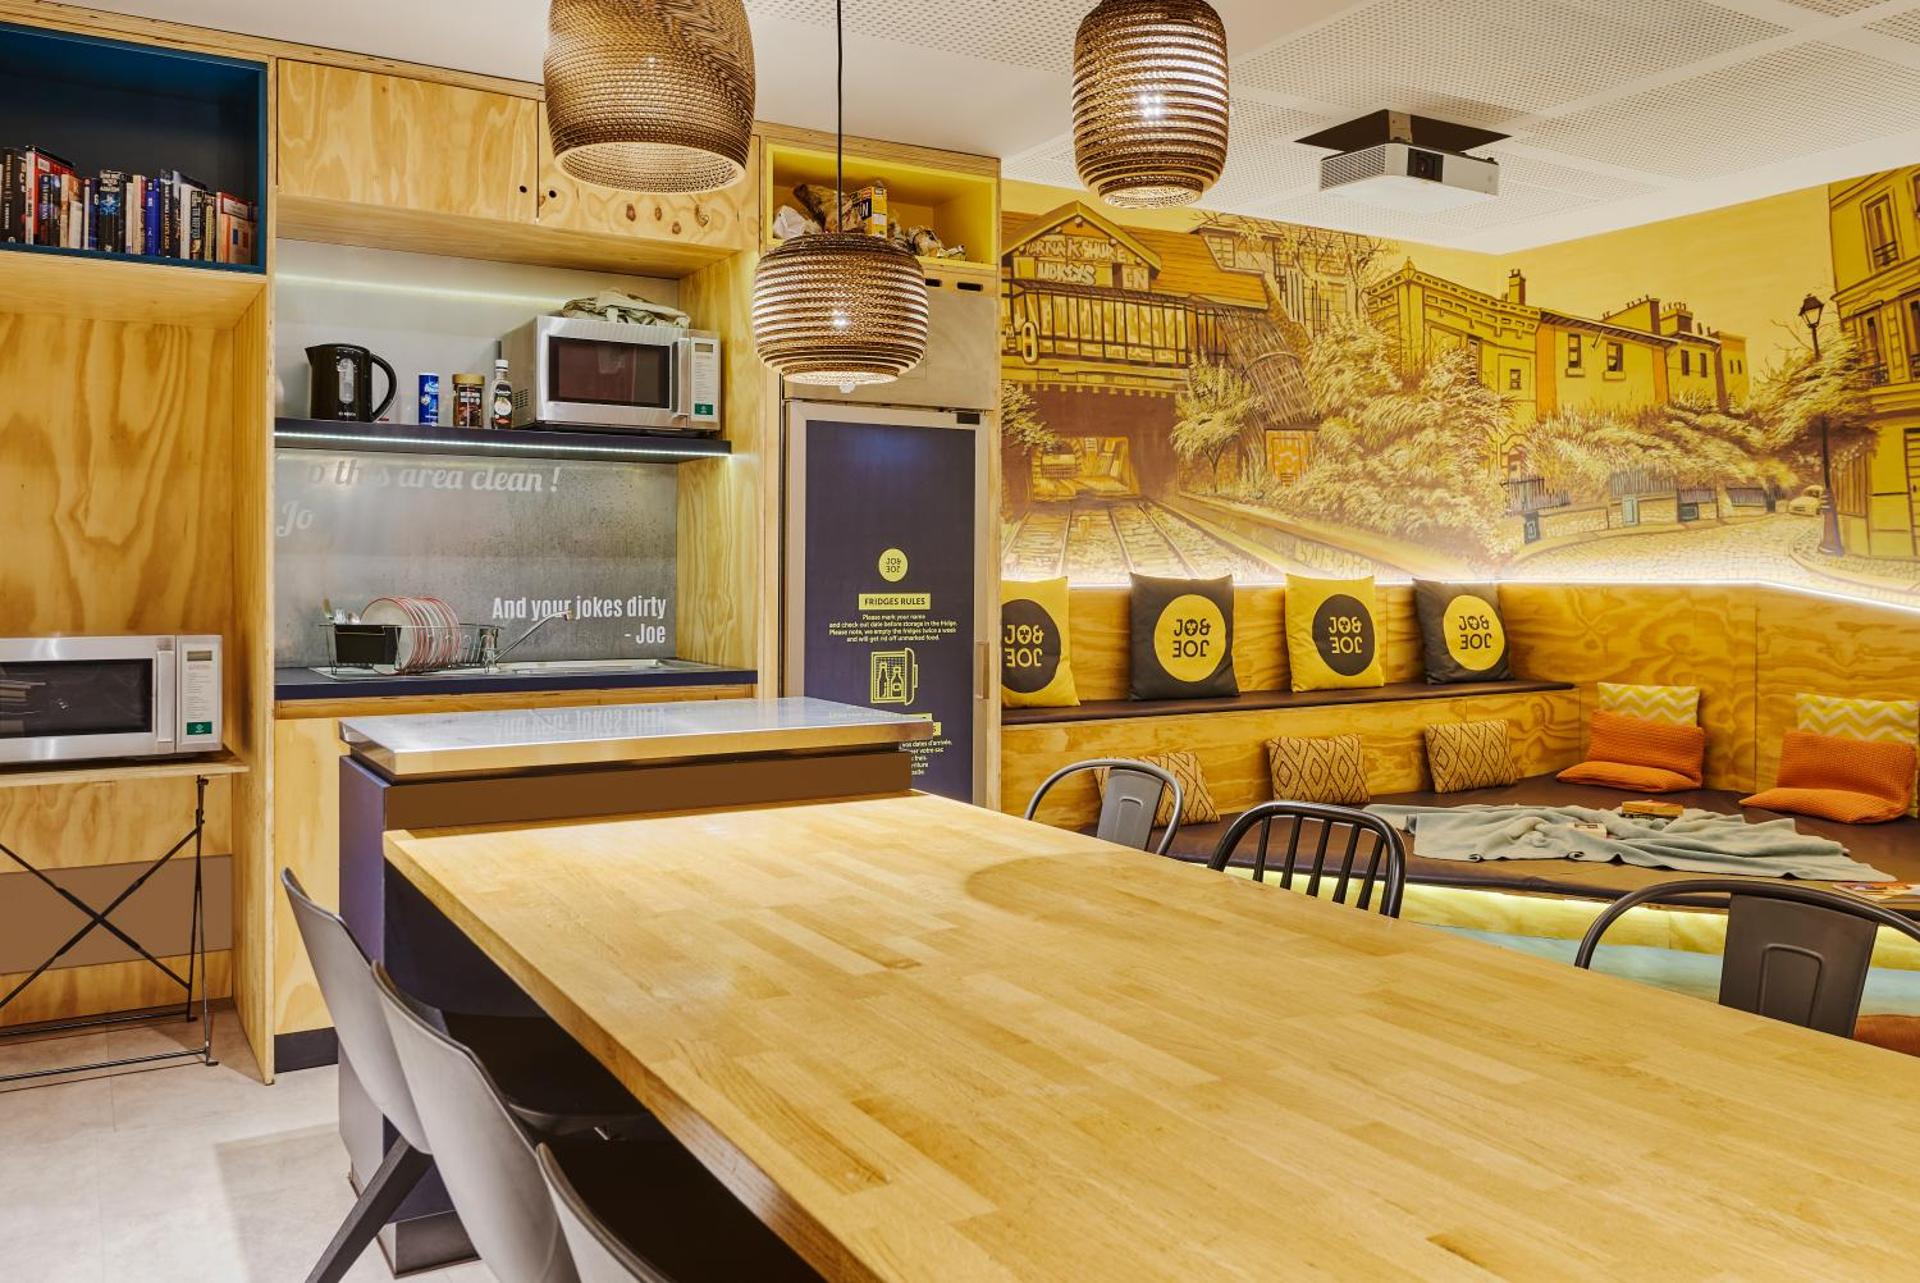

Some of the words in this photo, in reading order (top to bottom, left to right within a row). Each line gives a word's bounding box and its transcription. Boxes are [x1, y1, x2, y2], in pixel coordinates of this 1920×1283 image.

[400, 467, 464, 490] area
[471, 467, 543, 492] clean
[492, 597, 527, 619] And
[531, 598, 571, 621] your
[575, 595, 623, 620] jokes
[626, 595, 667, 619] dirty
[864, 597, 899, 606] FRIDGES
[900, 597, 926, 605] RULES
[635, 623, 666, 644] Joe
[829, 628, 847, 636] Please
